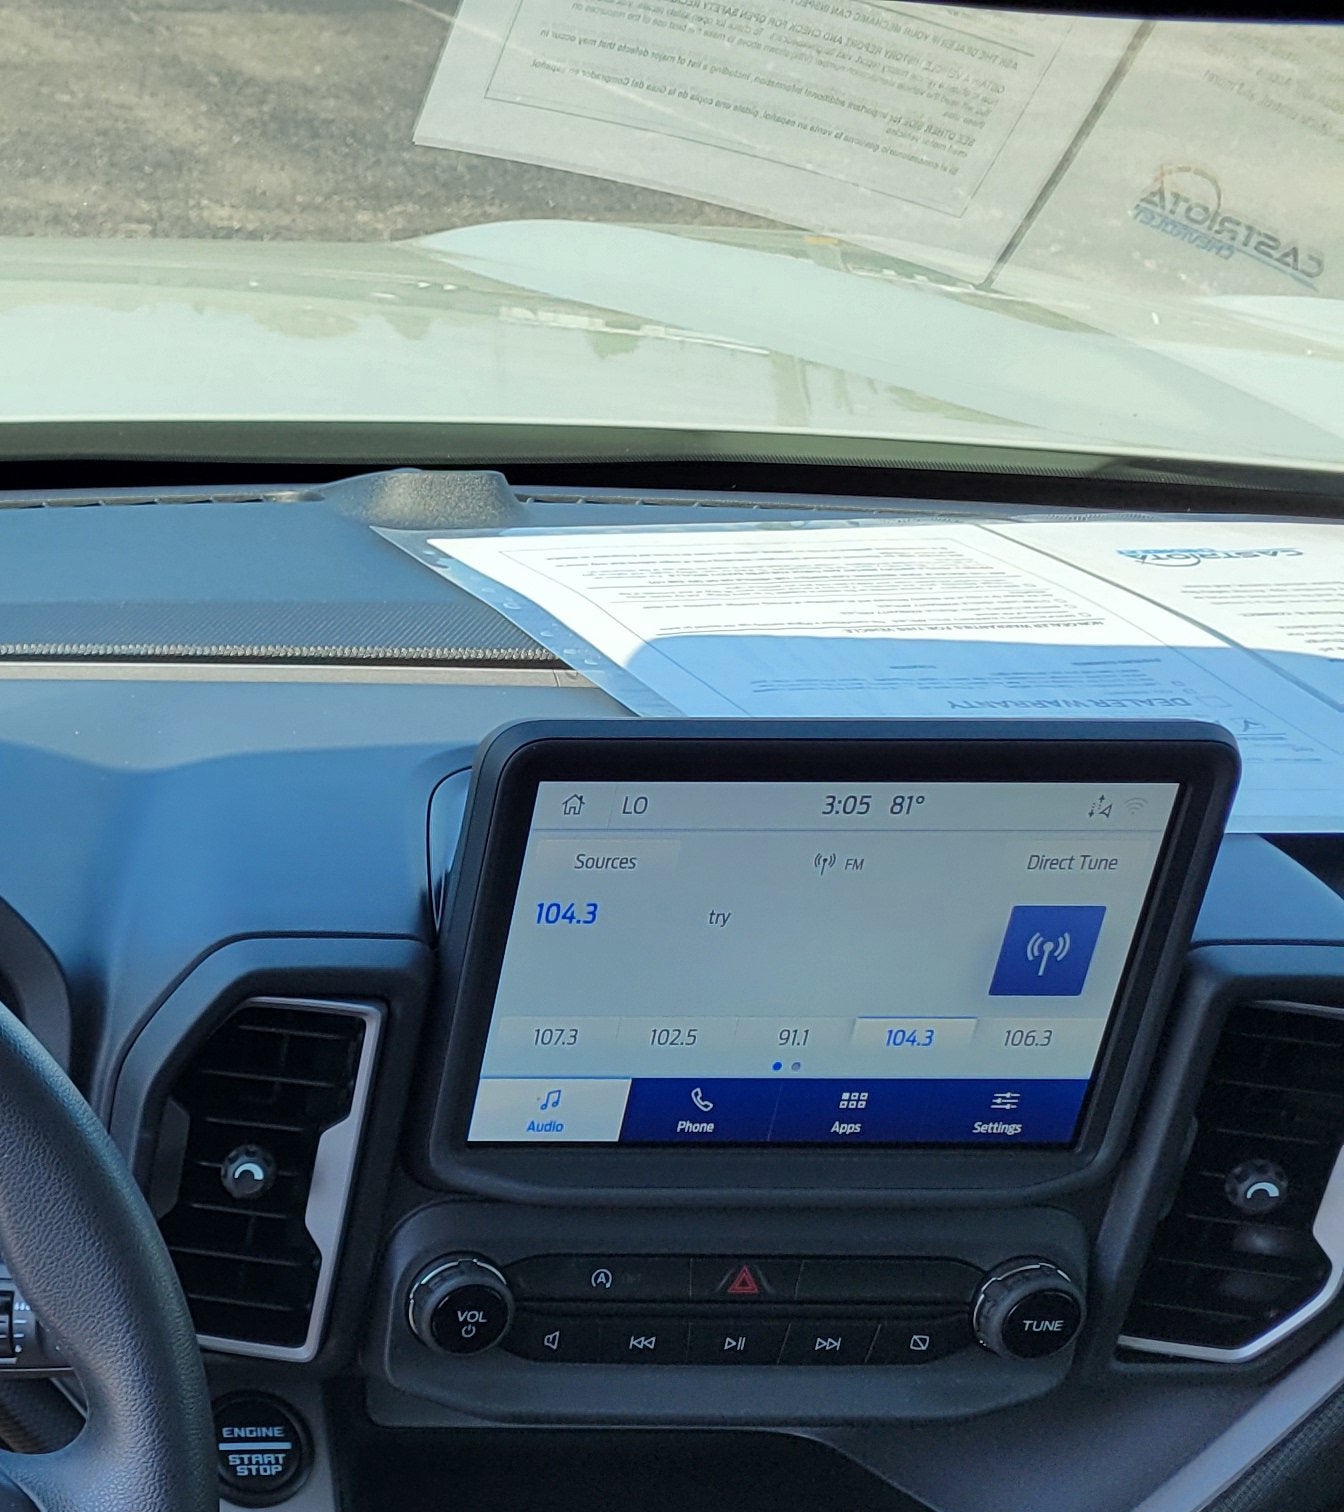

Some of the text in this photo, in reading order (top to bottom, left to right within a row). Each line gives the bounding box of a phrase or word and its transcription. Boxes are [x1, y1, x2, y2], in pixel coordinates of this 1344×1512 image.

[946, 696, 1193, 710] DEALER WARRANTY
[621, 795, 649, 815] LO
[820, 795, 925, 816] 3:05 81°
[573, 852, 637, 871] Sources
[844, 857, 865, 872] FM
[1026, 853, 1119, 871] Direct Tune
[534, 902, 598, 925] 104.3
[708, 909, 731, 928] try
[533, 1027, 1053, 1046] 107.3 102.5 91.1 104.3 106.3
[526, 1119, 1023, 1136] Audio Phone Apps Settings
[456, 1310, 487, 1324] VOL
[1022, 1319, 1064, 1332] TUNE
[222, 1426, 285, 1438] ENGINE
[228, 1453, 286, 1465] START
[236, 1465, 283, 1476] STOP
